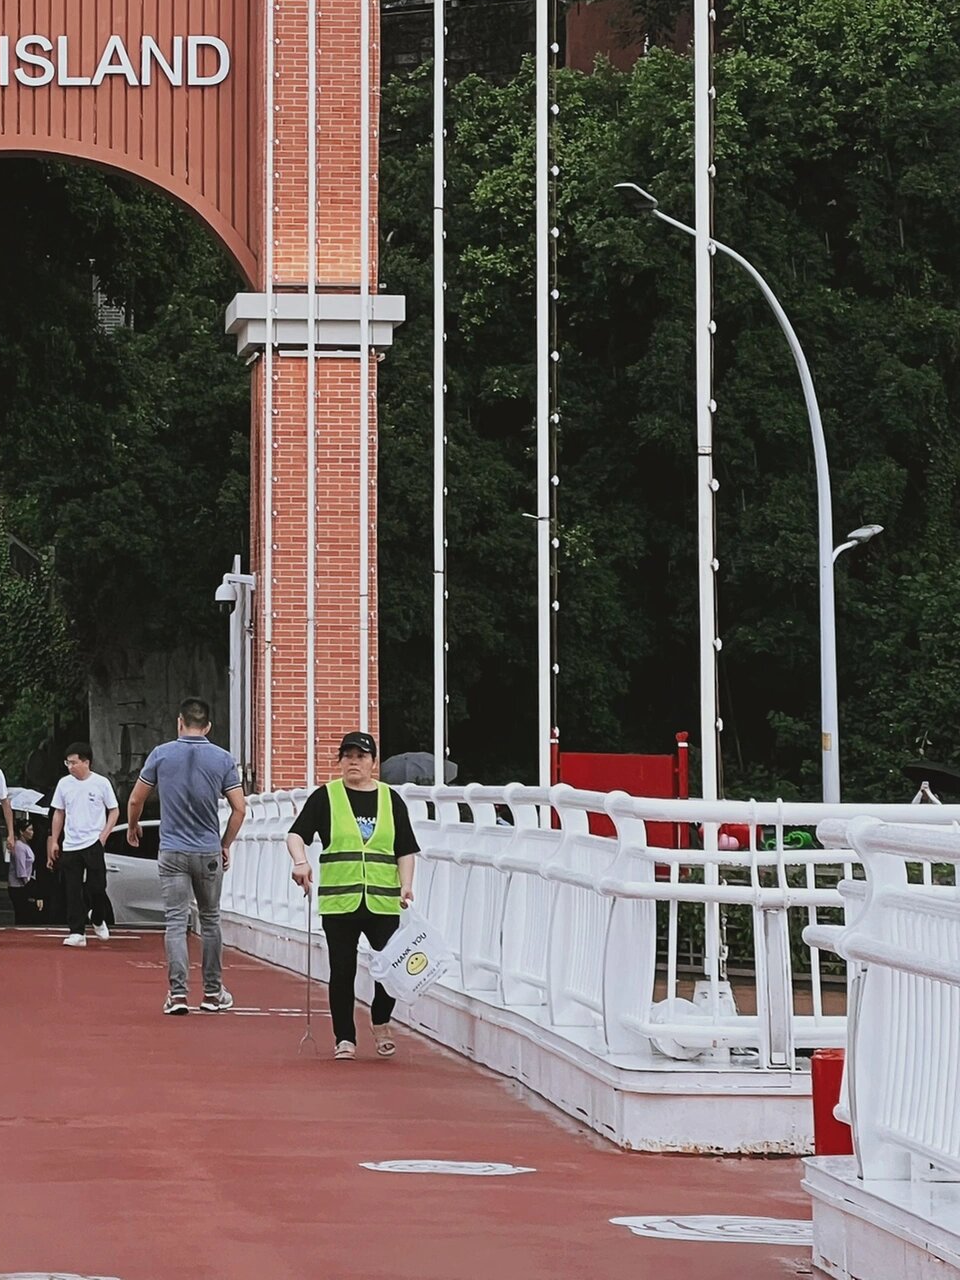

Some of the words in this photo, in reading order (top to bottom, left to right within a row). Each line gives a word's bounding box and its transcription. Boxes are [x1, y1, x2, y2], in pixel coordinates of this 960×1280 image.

[0, 34, 230, 87] ISLAND
[392, 947, 411, 969] THANK
[412, 932, 427, 946] YOU
